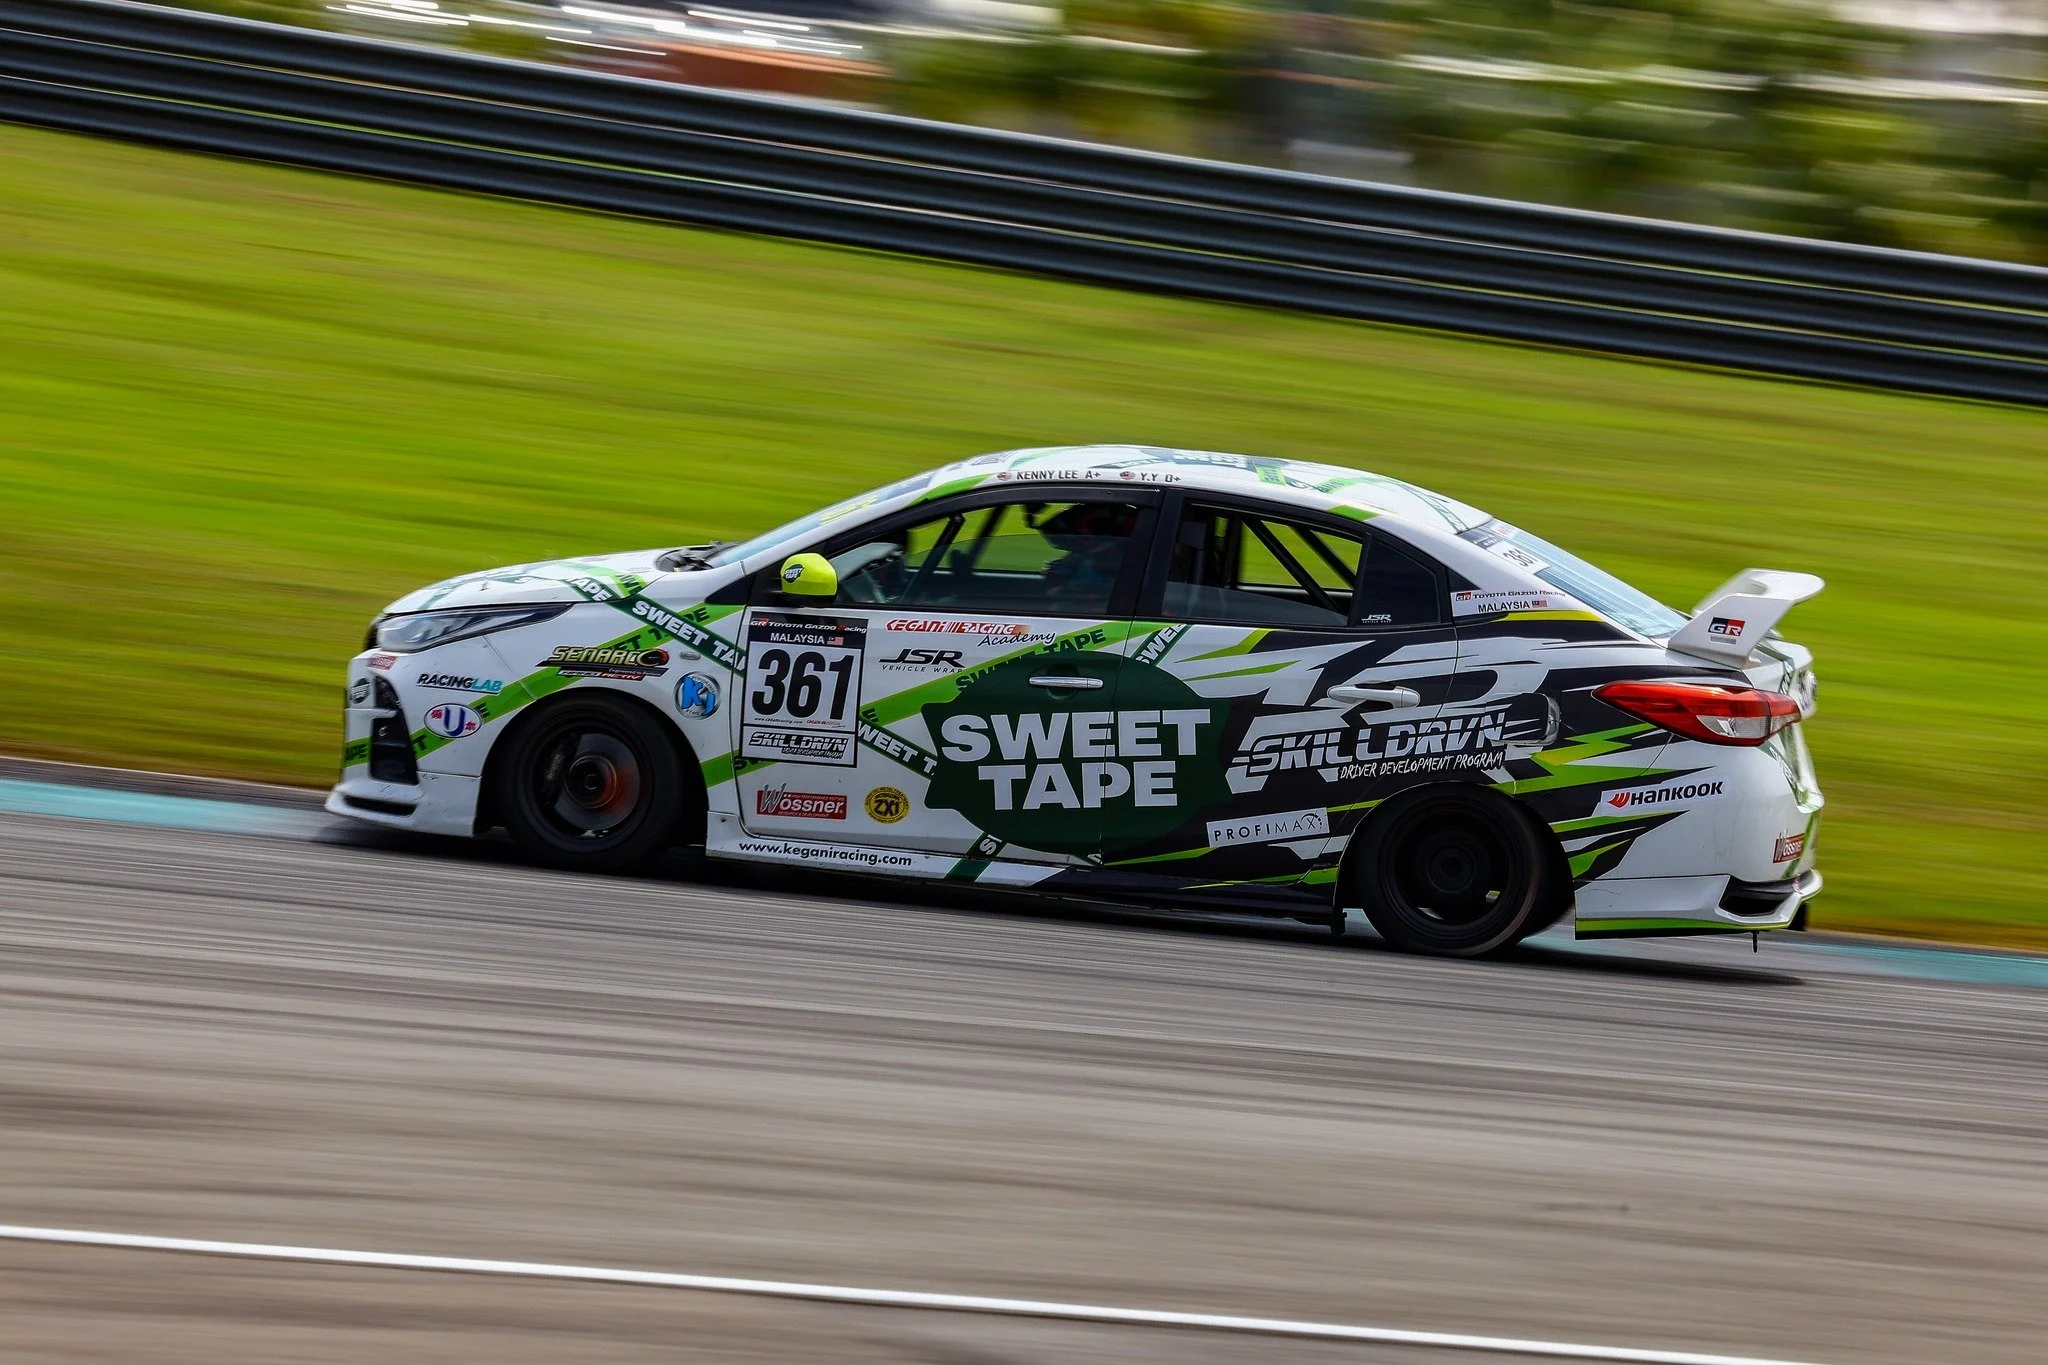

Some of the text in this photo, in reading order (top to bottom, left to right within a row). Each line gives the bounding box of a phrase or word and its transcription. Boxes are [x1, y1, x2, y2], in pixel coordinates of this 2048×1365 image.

[1016, 470, 1102, 481] KENNY LEE A+
[1140, 472, 1159, 483] Y.Y
[1473, 591, 1507, 600] TOYOTA
[1477, 600, 1531, 613] MALAYSIA
[632, 601, 710, 646] SWEET
[768, 621, 803, 629] TOYOTA
[804, 623, 837, 631] GAZOO
[1361, 614, 1392, 622] JSR
[770, 632, 825, 644] MALAYSIA
[1709, 622, 1743, 637] GR
[977, 631, 1056, 648] Academy
[878, 648, 966, 668] JSR
[882, 664, 926, 673] VEHICLE
[752, 648, 855, 720] 361
[858, 720, 918, 763] WEET
[941, 710, 1211, 763] SWEET
[1249, 712, 1506, 774] SKILLDRVN
[1340, 750, 1504, 779] DRIVER DEVELOPMENT PROGRAM
[978, 761, 1178, 811] TAPE
[738, 842, 912, 867] www.keganiracing.com
